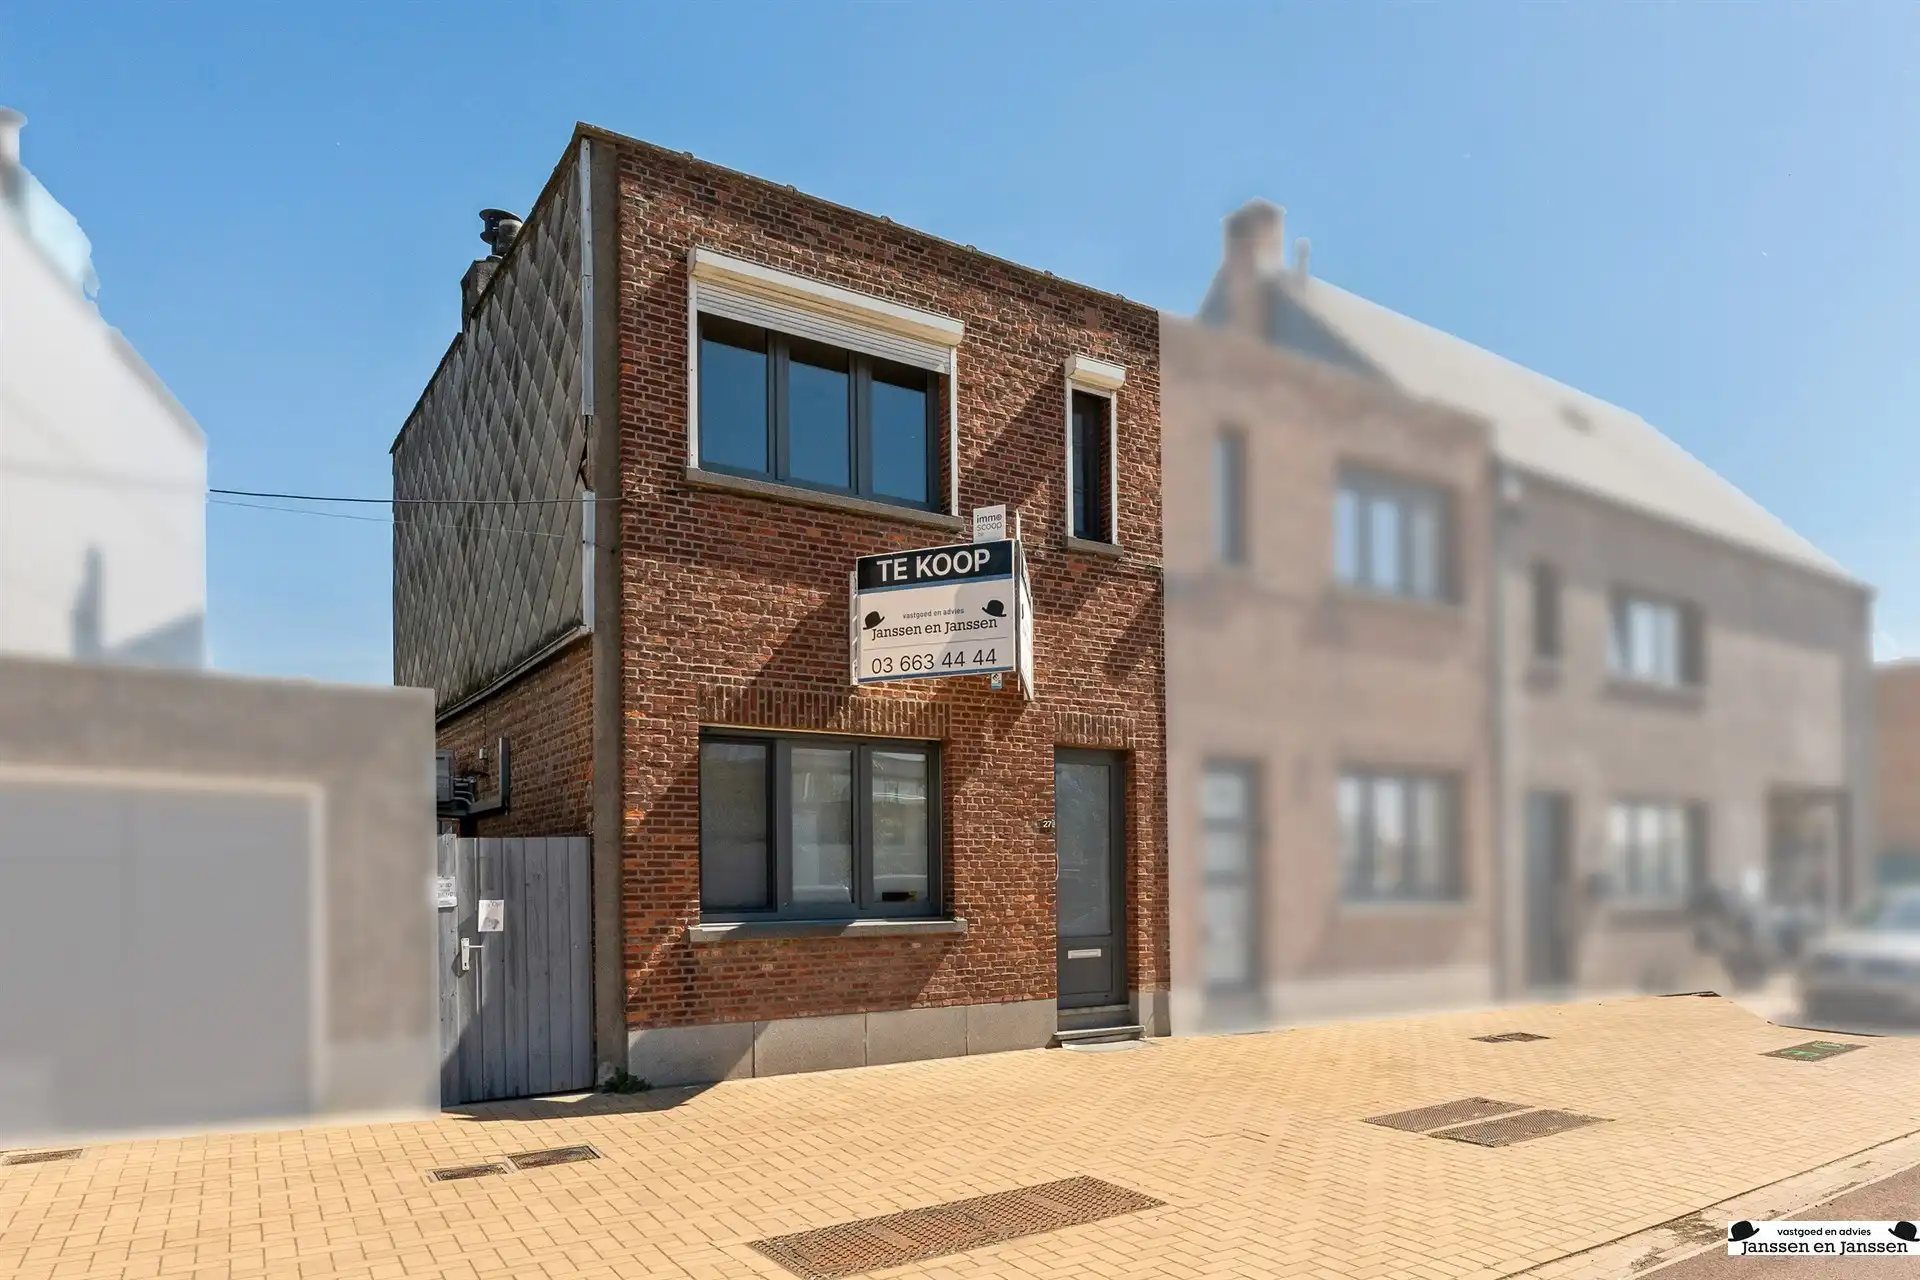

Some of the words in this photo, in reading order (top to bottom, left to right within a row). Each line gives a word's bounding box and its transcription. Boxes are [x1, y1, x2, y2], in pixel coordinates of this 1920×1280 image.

[976, 522, 1003, 532] scoop
[876, 557, 908, 582] TE
[916, 548, 991, 579] KOOP
[902, 610, 932, 620] vastgoed
[943, 607, 965, 616] advies
[871, 625, 922, 641] Janssen
[924, 624, 942, 634] en
[944, 619, 998, 634] Janssen
[871, 657, 894, 675] 03
[899, 653, 935, 672] 663
[941, 651, 966, 669] 44
[972, 648, 997, 666] 44
